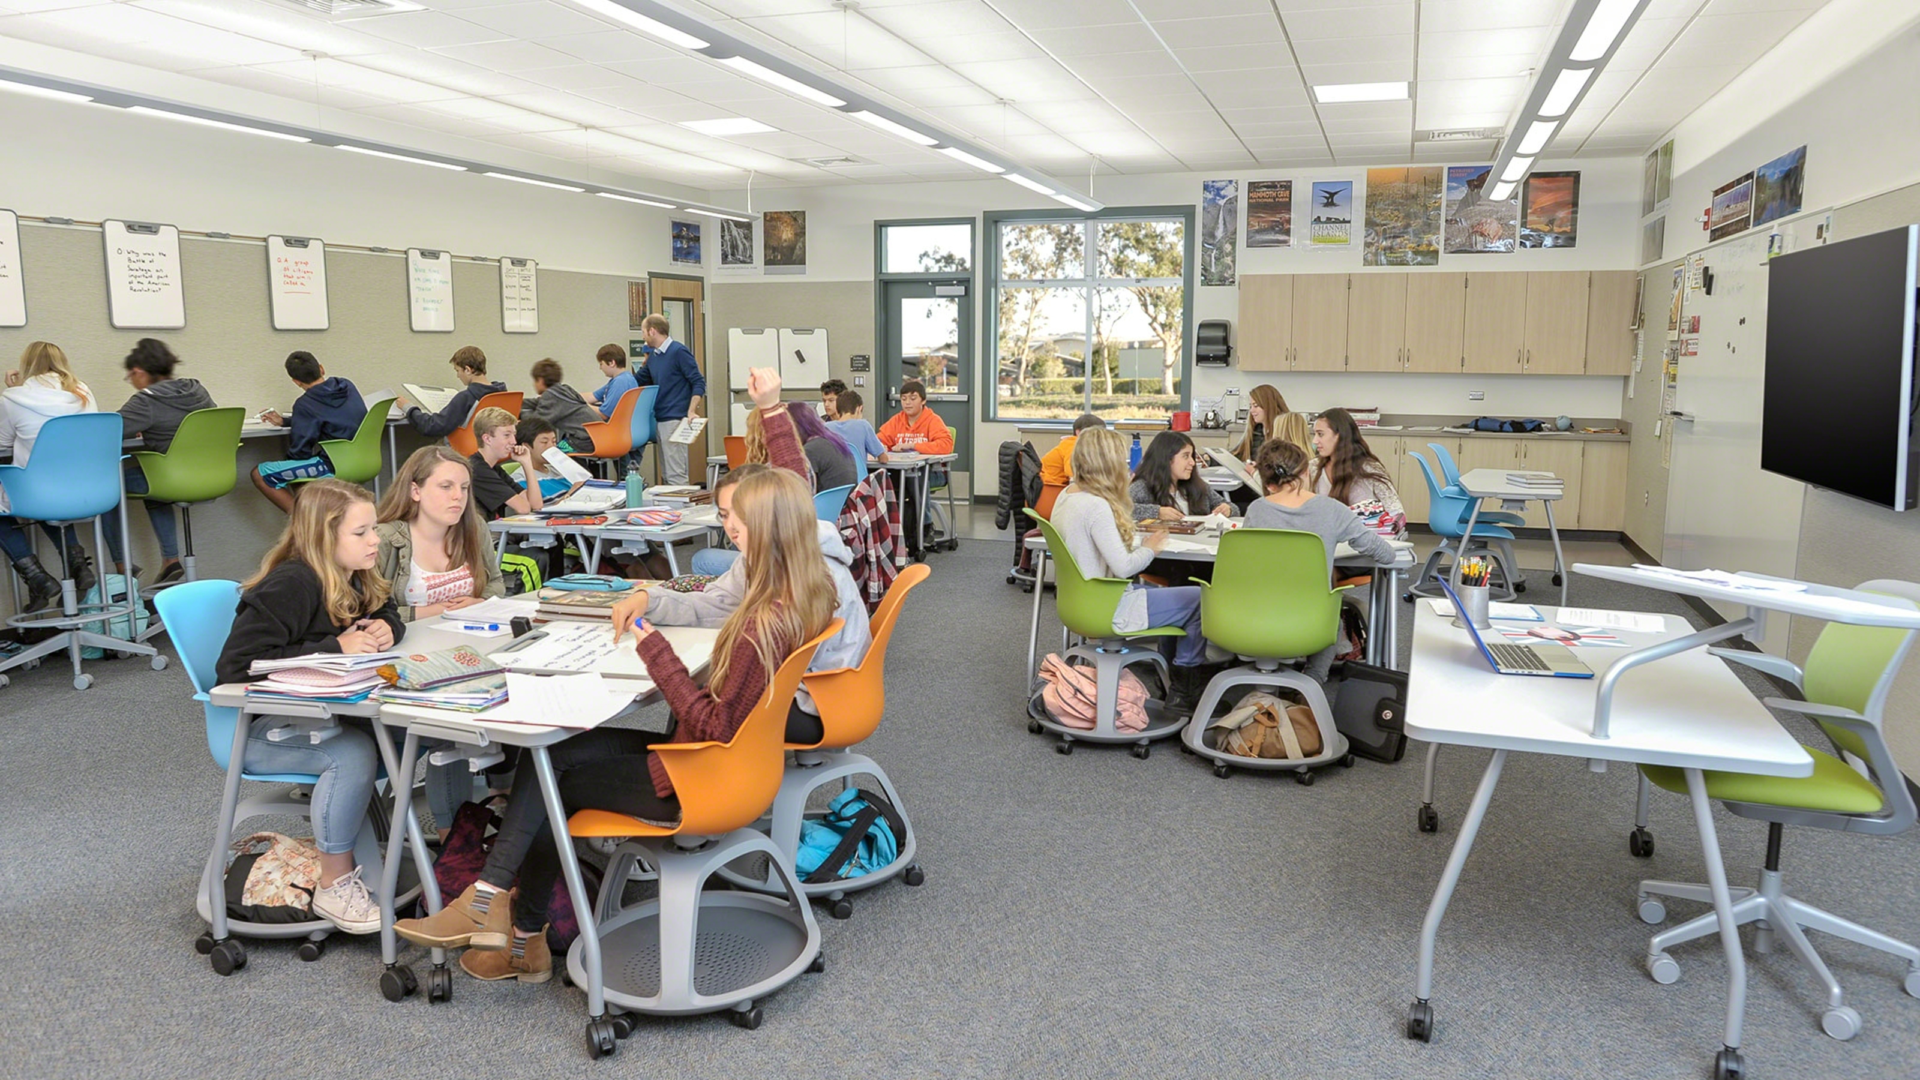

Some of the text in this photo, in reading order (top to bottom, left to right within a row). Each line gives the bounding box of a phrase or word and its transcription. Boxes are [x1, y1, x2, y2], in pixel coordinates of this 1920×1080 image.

[1249, 190, 1290, 198] MAMMOTH CAVE
[1313, 230, 1349, 238] ISLANDS
